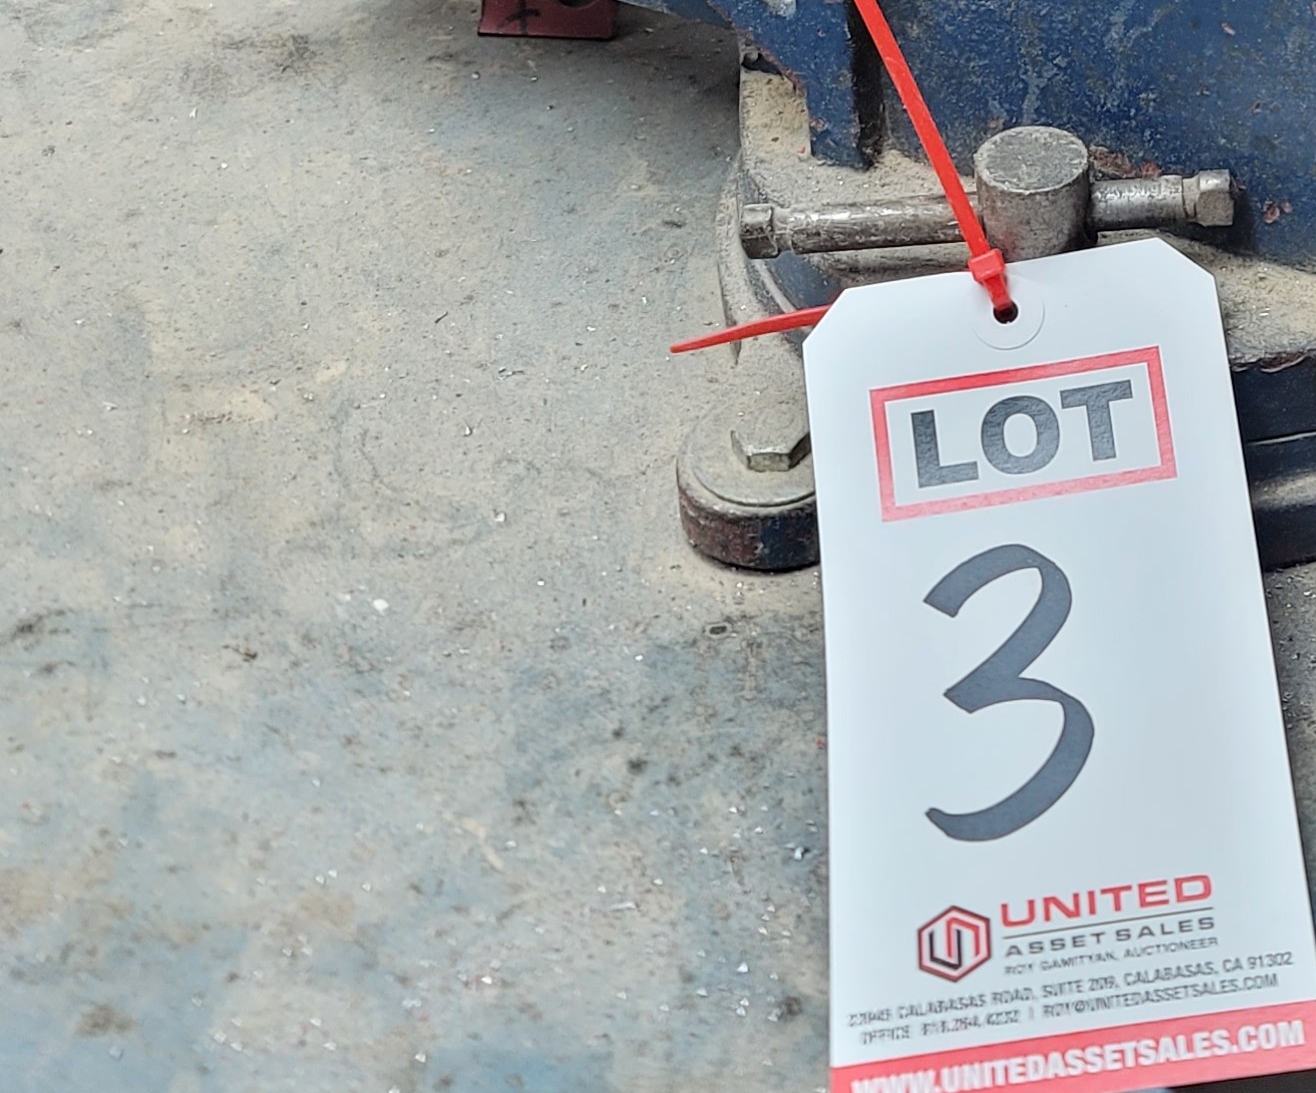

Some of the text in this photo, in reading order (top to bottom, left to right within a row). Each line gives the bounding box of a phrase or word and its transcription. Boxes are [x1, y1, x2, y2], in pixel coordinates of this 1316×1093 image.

[910, 380, 1134, 488] LOT
[923, 543, 1095, 842] 3
[1000, 874, 1213, 928] UNITED
[1004, 916, 1215, 957] ASSET SALES
[1123, 936, 1219, 958] AUCTIONEER
[898, 993, 987, 1020] CALABASAS
[1042, 978, 1084, 997] SUITE
[1123, 960, 1219, 987] CALABASAS,
[1222, 955, 1244, 972] CA
[1247, 951, 1293, 970] 91302
[851, 1019, 1306, 1093] WWW.UNITEDASSETSALES.COM
